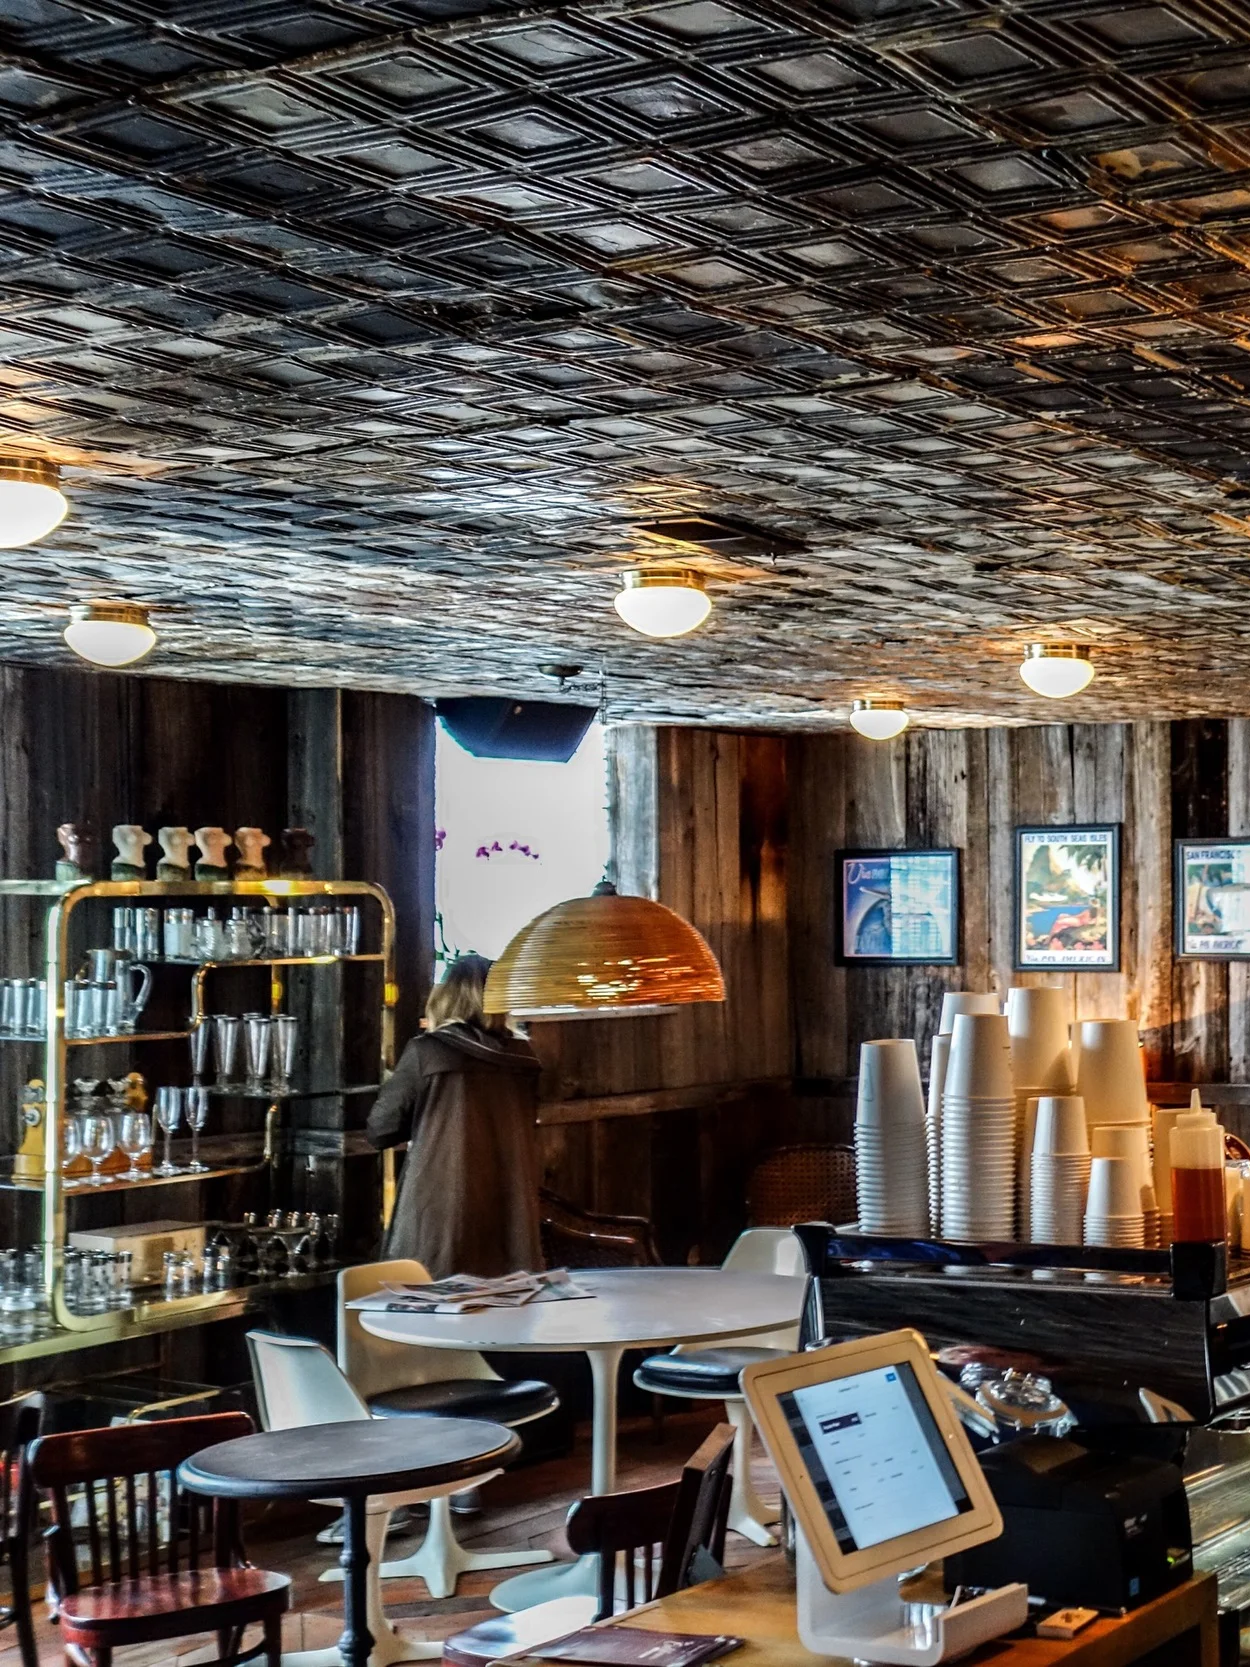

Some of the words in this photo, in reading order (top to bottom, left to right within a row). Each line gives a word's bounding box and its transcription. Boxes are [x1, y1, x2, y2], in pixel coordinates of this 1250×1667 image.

[1047, 834, 1067, 842] SOUTH
[1071, 834, 1086, 842] SEAS
[1090, 834, 1107, 842] ISLES
[1187, 851, 1199, 859] SAN
